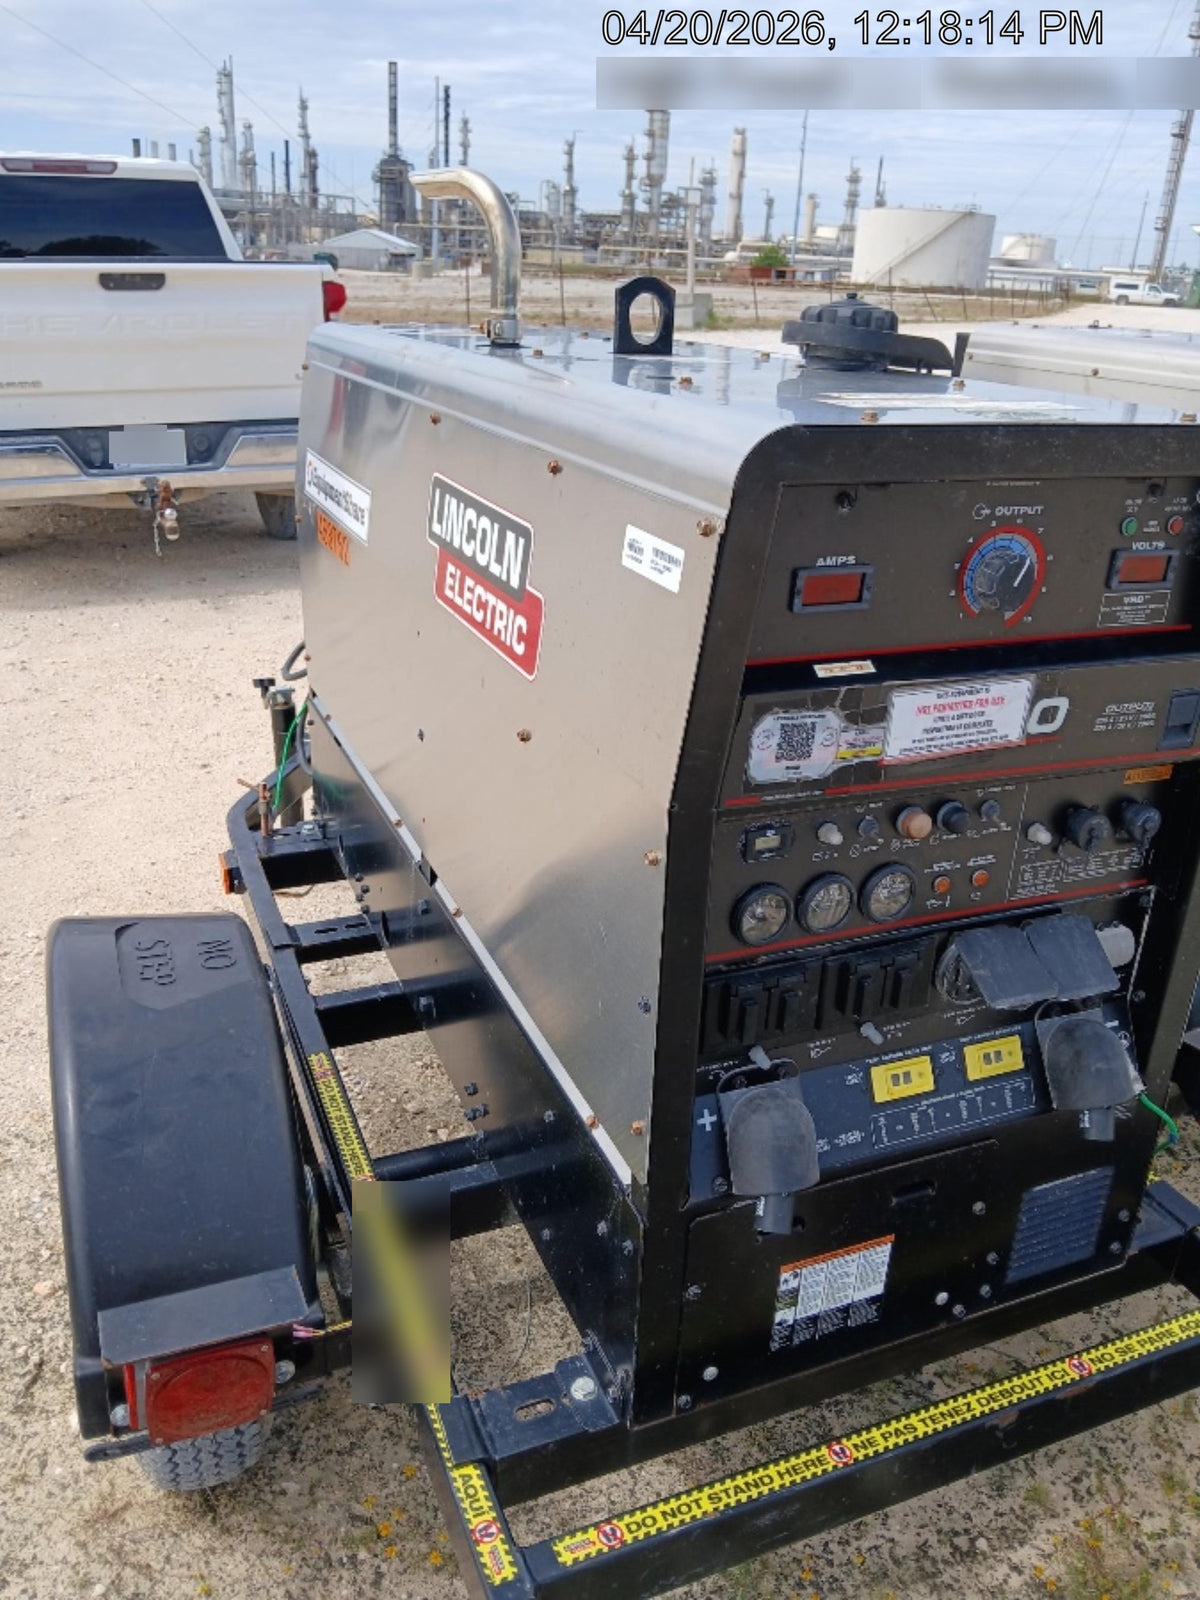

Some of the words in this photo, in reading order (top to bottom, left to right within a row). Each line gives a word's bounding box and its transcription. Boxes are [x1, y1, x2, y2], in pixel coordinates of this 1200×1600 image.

[995, 505, 1044, 517] OUTPUT
[431, 488, 525, 590] LINCOLN
[1131, 540, 1166, 551] VOLTS
[815, 555, 857, 567] AMPS
[444, 561, 527, 656] ELECTRIC
[135, 939, 177, 986] STEP
[197, 938, 237, 970] NO
[327, 1094, 342, 1113] NOT
[334, 1113, 354, 1148] STAND
[348, 1148, 365, 1175] HERE
[625, 1515, 657, 1534] DO
[660, 1499, 703, 1522] NOT
[707, 1474, 775, 1504] STAND
[776, 1454, 830, 1480] HERE
[852, 1437, 879, 1453] NE
[880, 1423, 917, 1444] PAS
[918, 1402, 976, 1429] TENEZ
[977, 1377, 1045, 1408] DEBOUT
[1046, 1369, 1070, 1382] ICI
[1088, 1352, 1115, 1366] NO
[1115, 1343, 1137, 1357] SE
[1137, 1328, 1179, 1348] PARE
[1179, 1320, 1200, 1333] AQ
